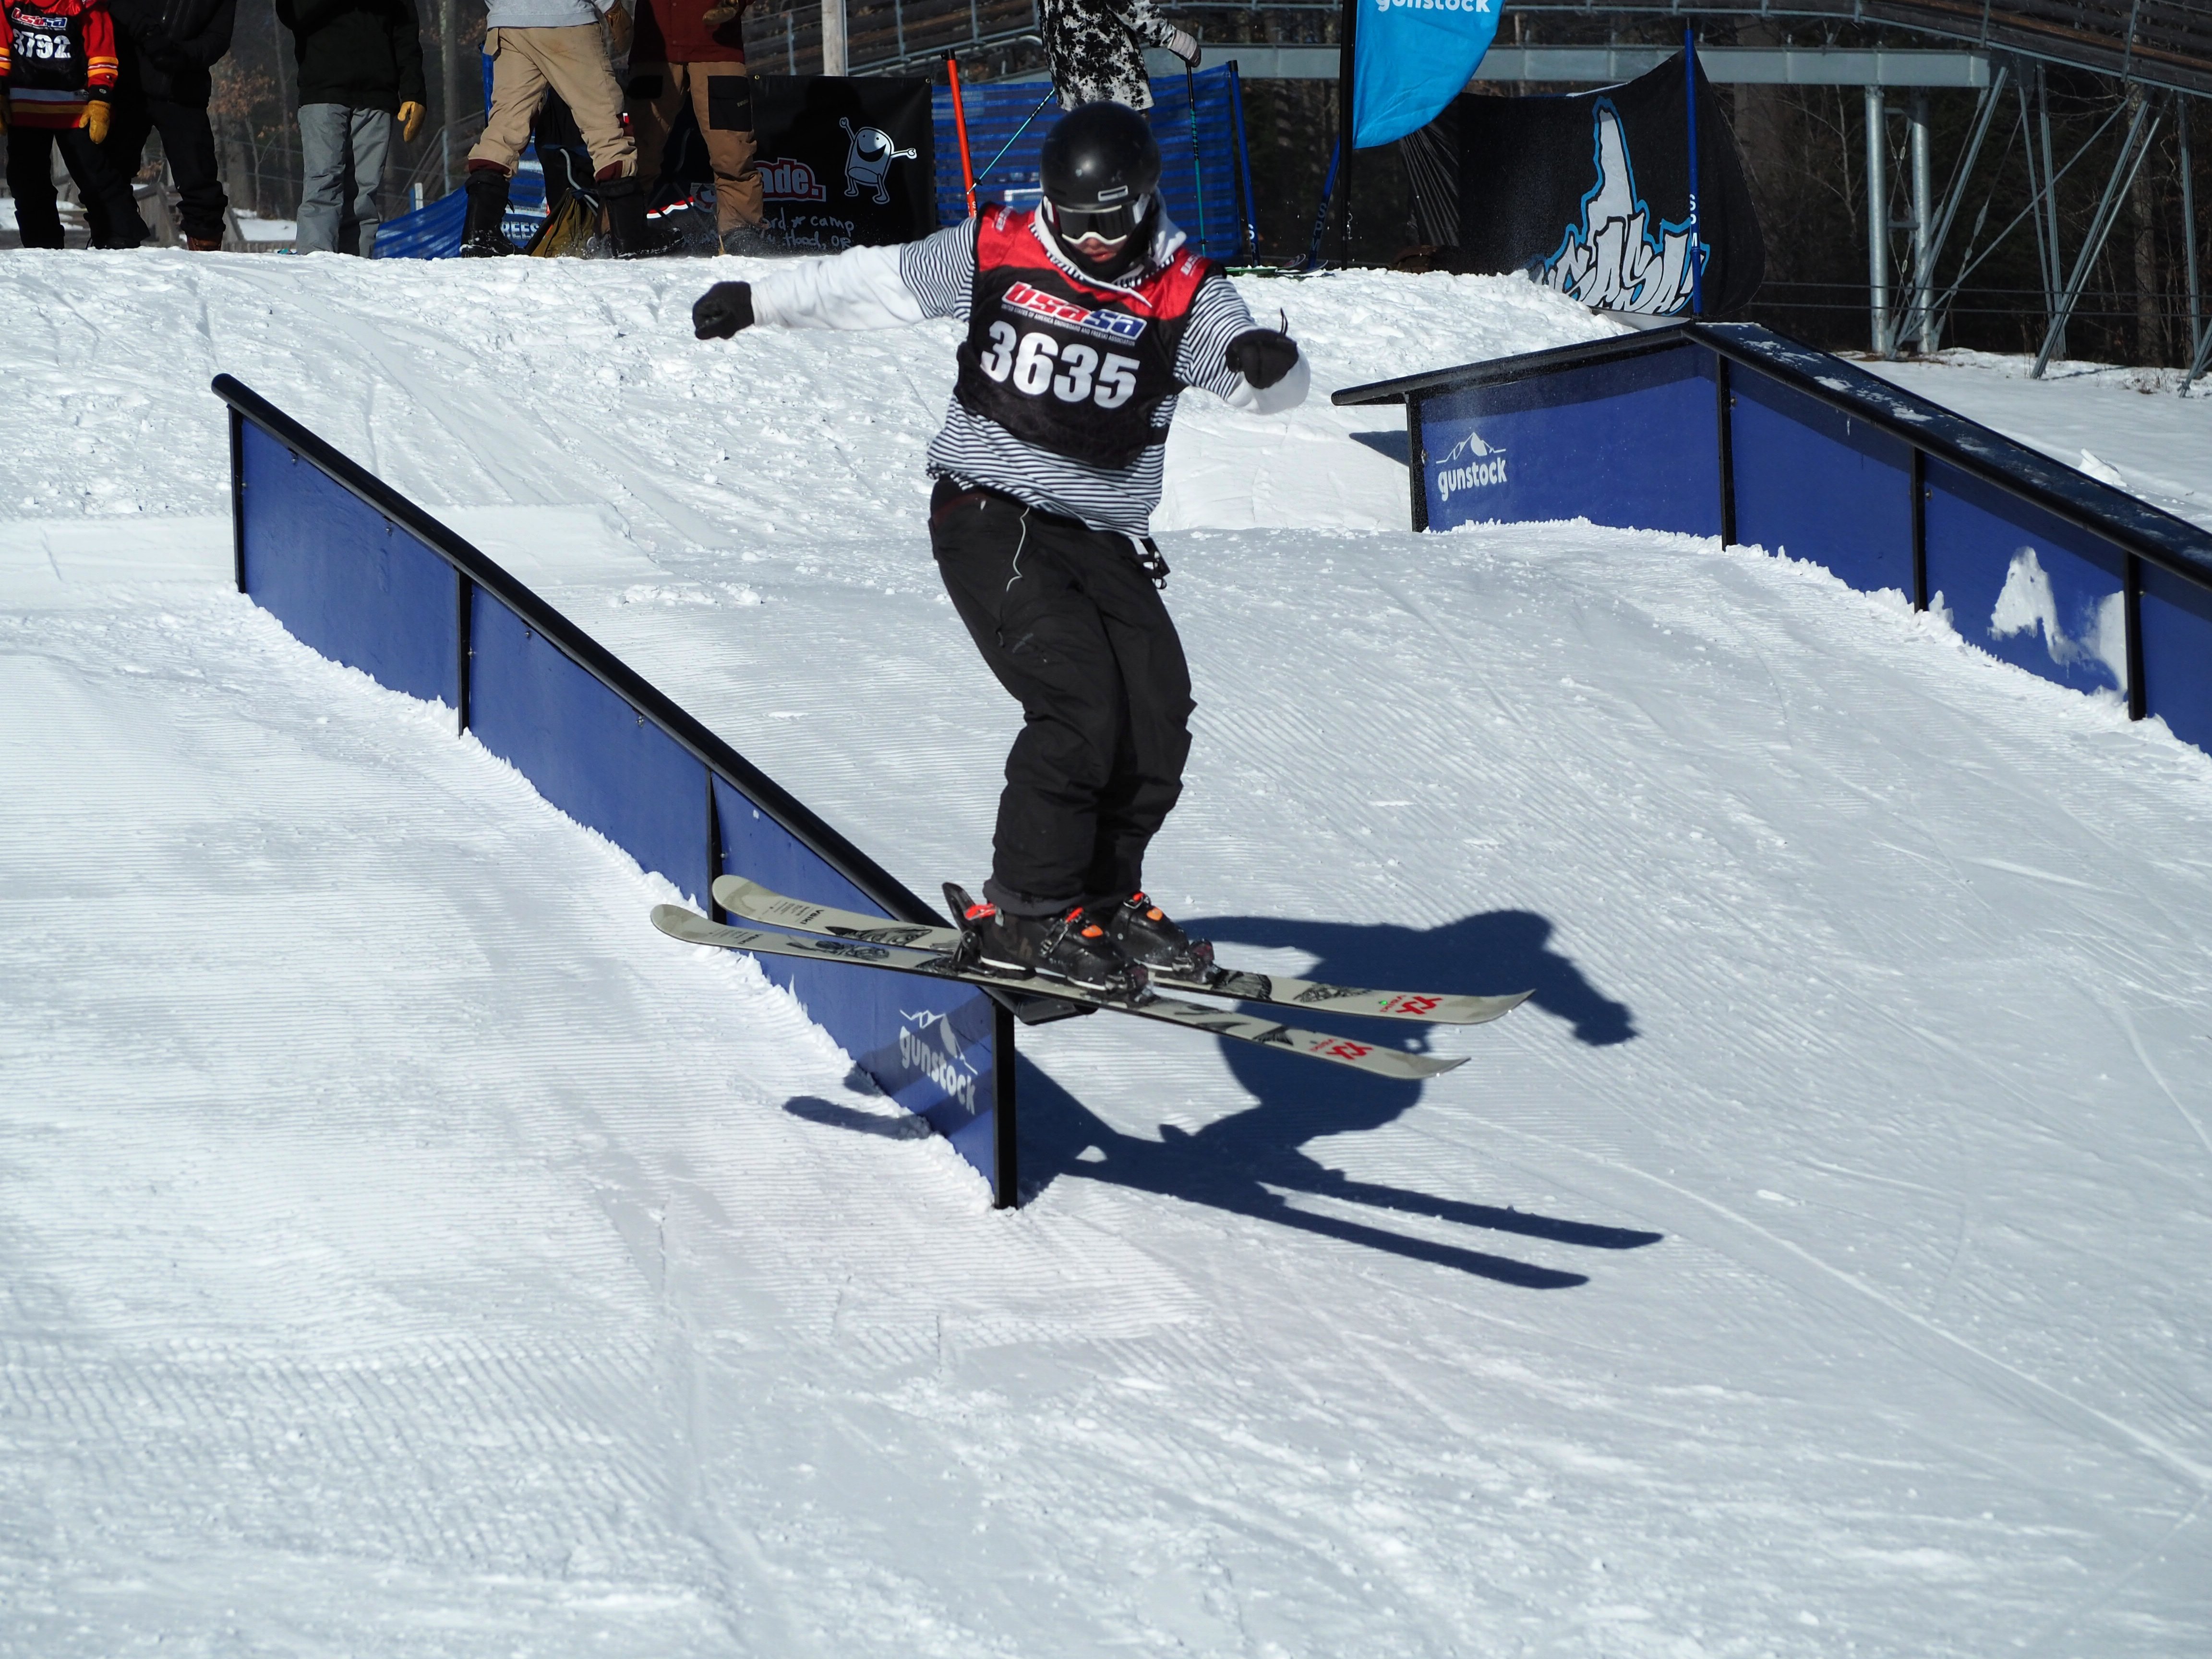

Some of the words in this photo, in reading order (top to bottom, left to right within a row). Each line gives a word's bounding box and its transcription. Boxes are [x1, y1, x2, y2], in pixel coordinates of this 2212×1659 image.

[12, 28, 71, 59] 3792
[758, 164, 819, 194] ade.
[810, 216, 854, 237] camp
[980, 320, 1140, 409] 3635
[1438, 457, 1507, 501] gunstock
[900, 1025, 975, 1116] gunstock
